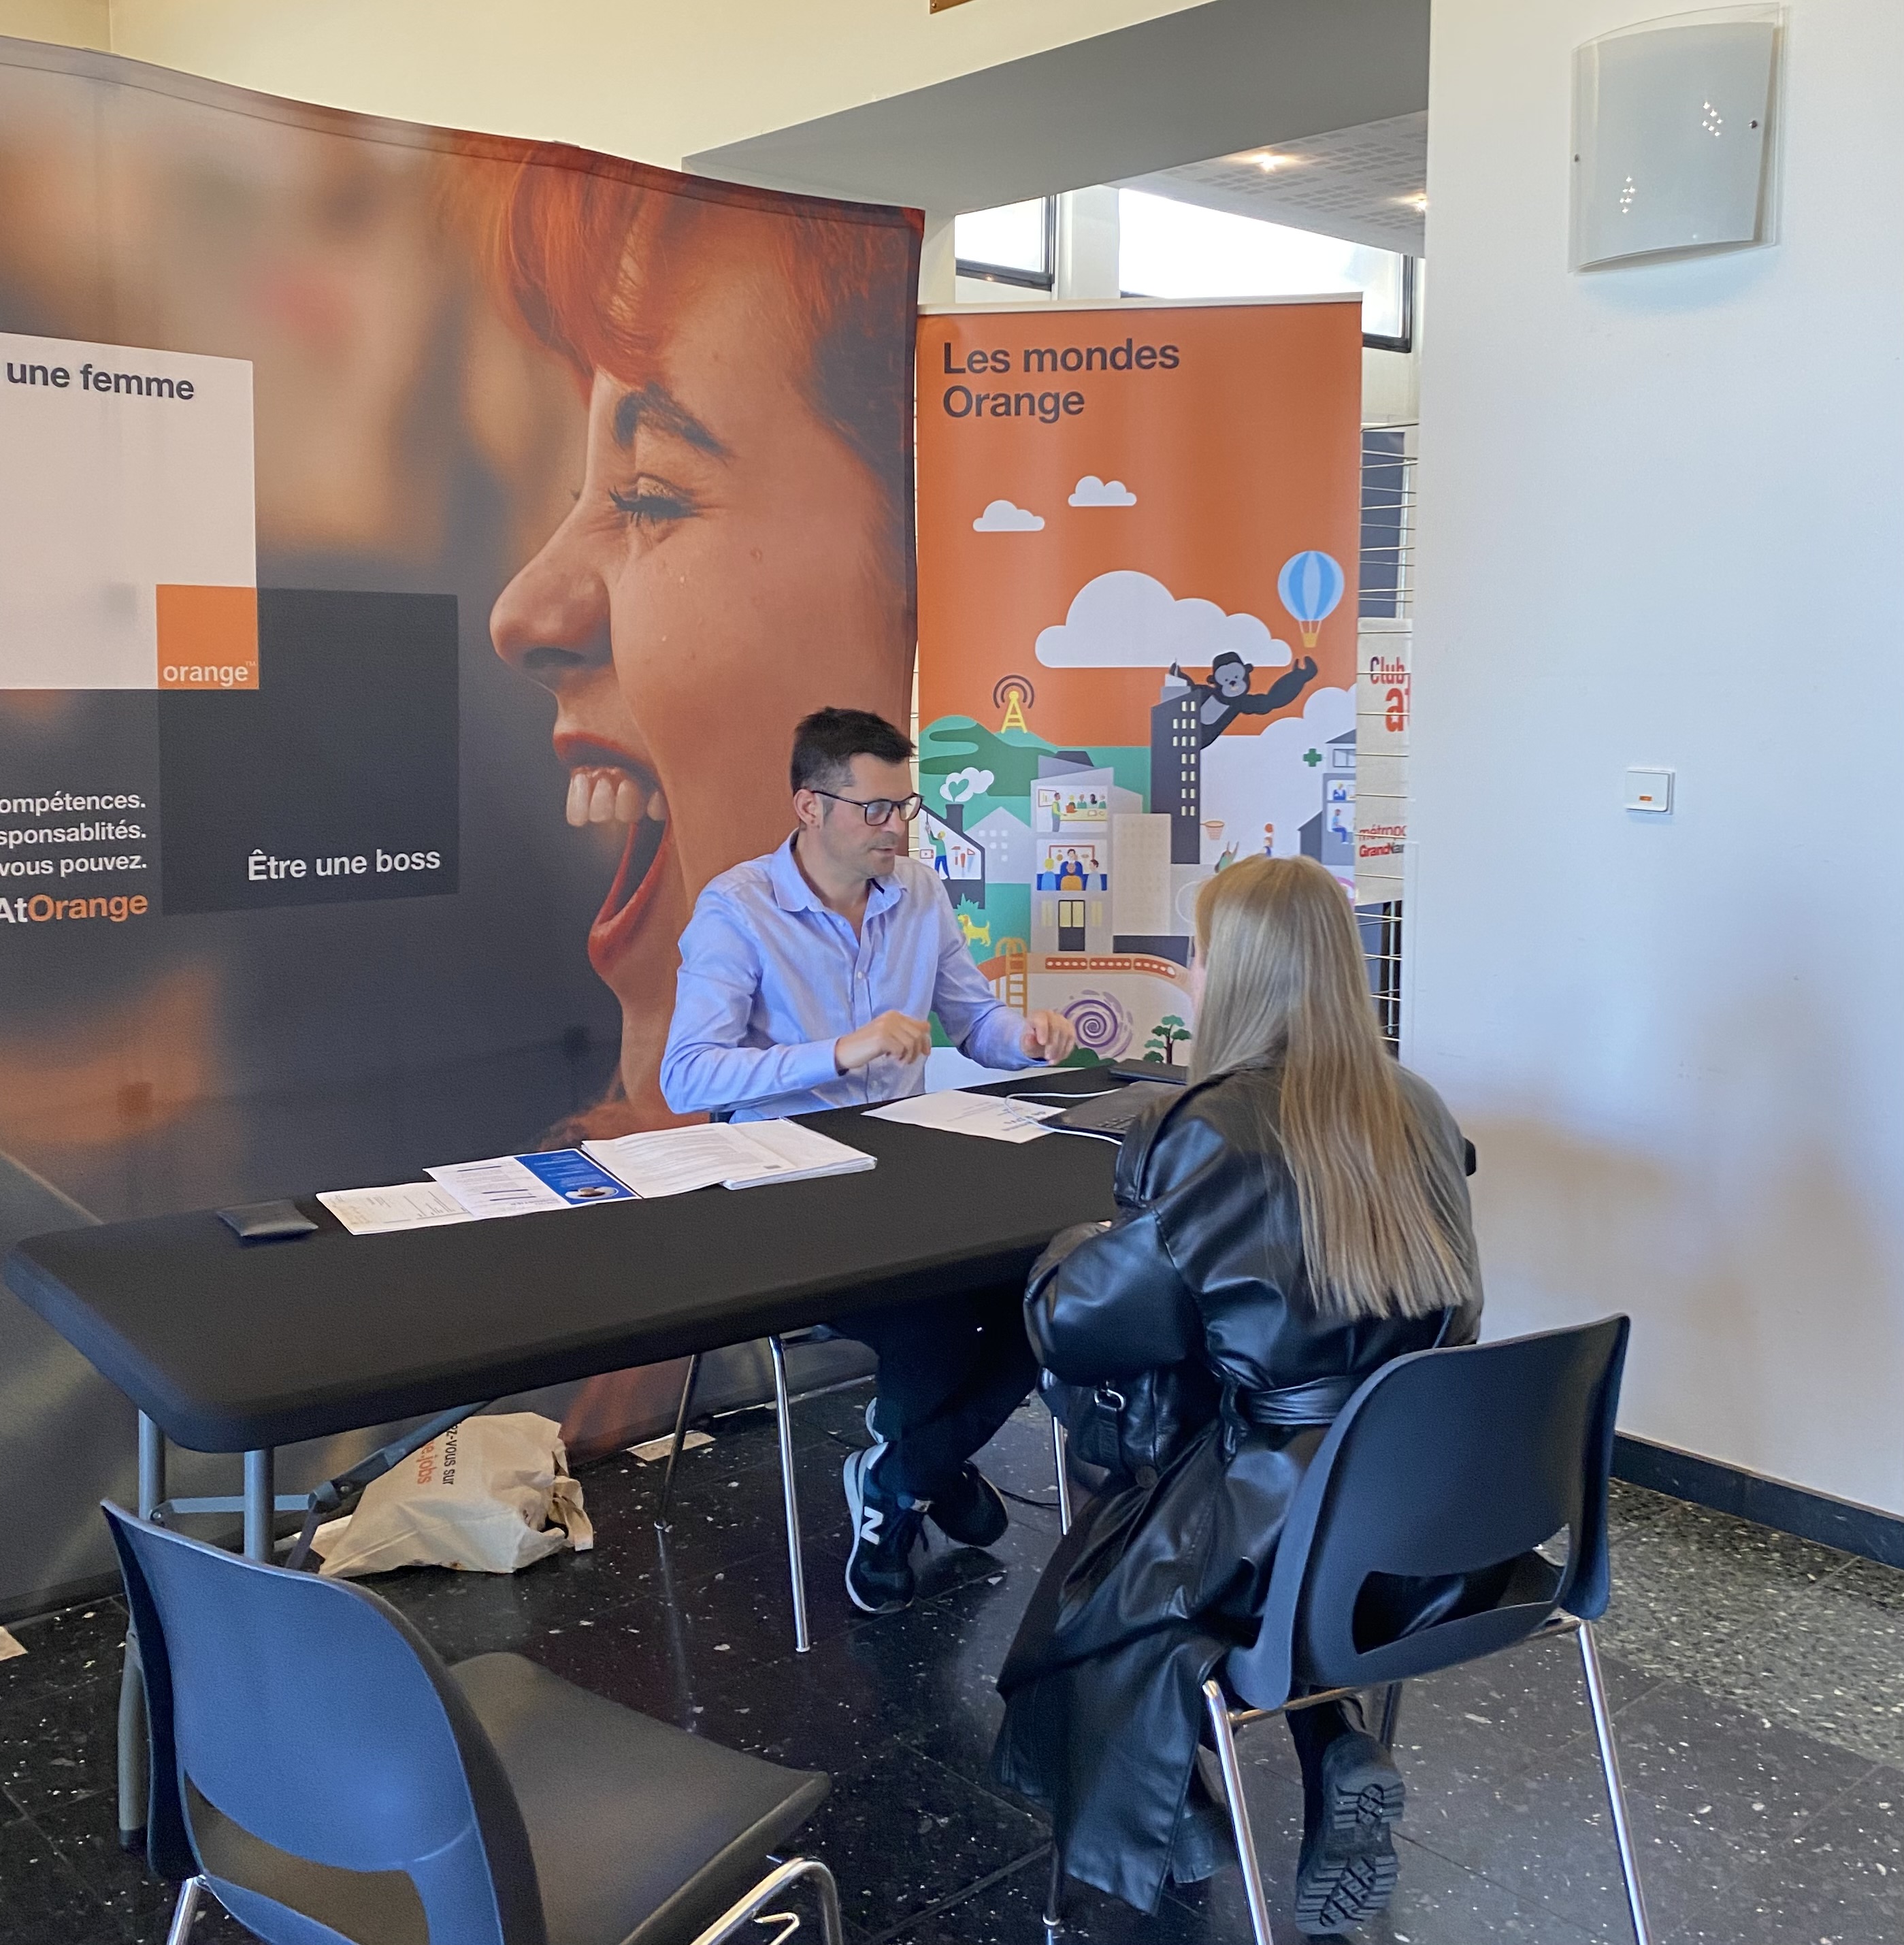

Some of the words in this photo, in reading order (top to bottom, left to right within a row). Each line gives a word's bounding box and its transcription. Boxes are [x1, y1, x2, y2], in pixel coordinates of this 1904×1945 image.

[943, 342, 1011, 374] Les
[1023, 338, 1179, 372] mondes
[6, 361, 70, 389] une
[80, 363, 195, 400] femme
[943, 385, 1085, 423] Orange
[163, 665, 248, 687] orange
[1370, 656, 1405, 685] Club
[0, 858, 53, 877] vous
[60, 853, 147, 878] pouvez.
[248, 849, 307, 881] Être
[315, 853, 367, 877] une
[375, 849, 441, 873] boss
[443, 1469, 455, 1485] sur
